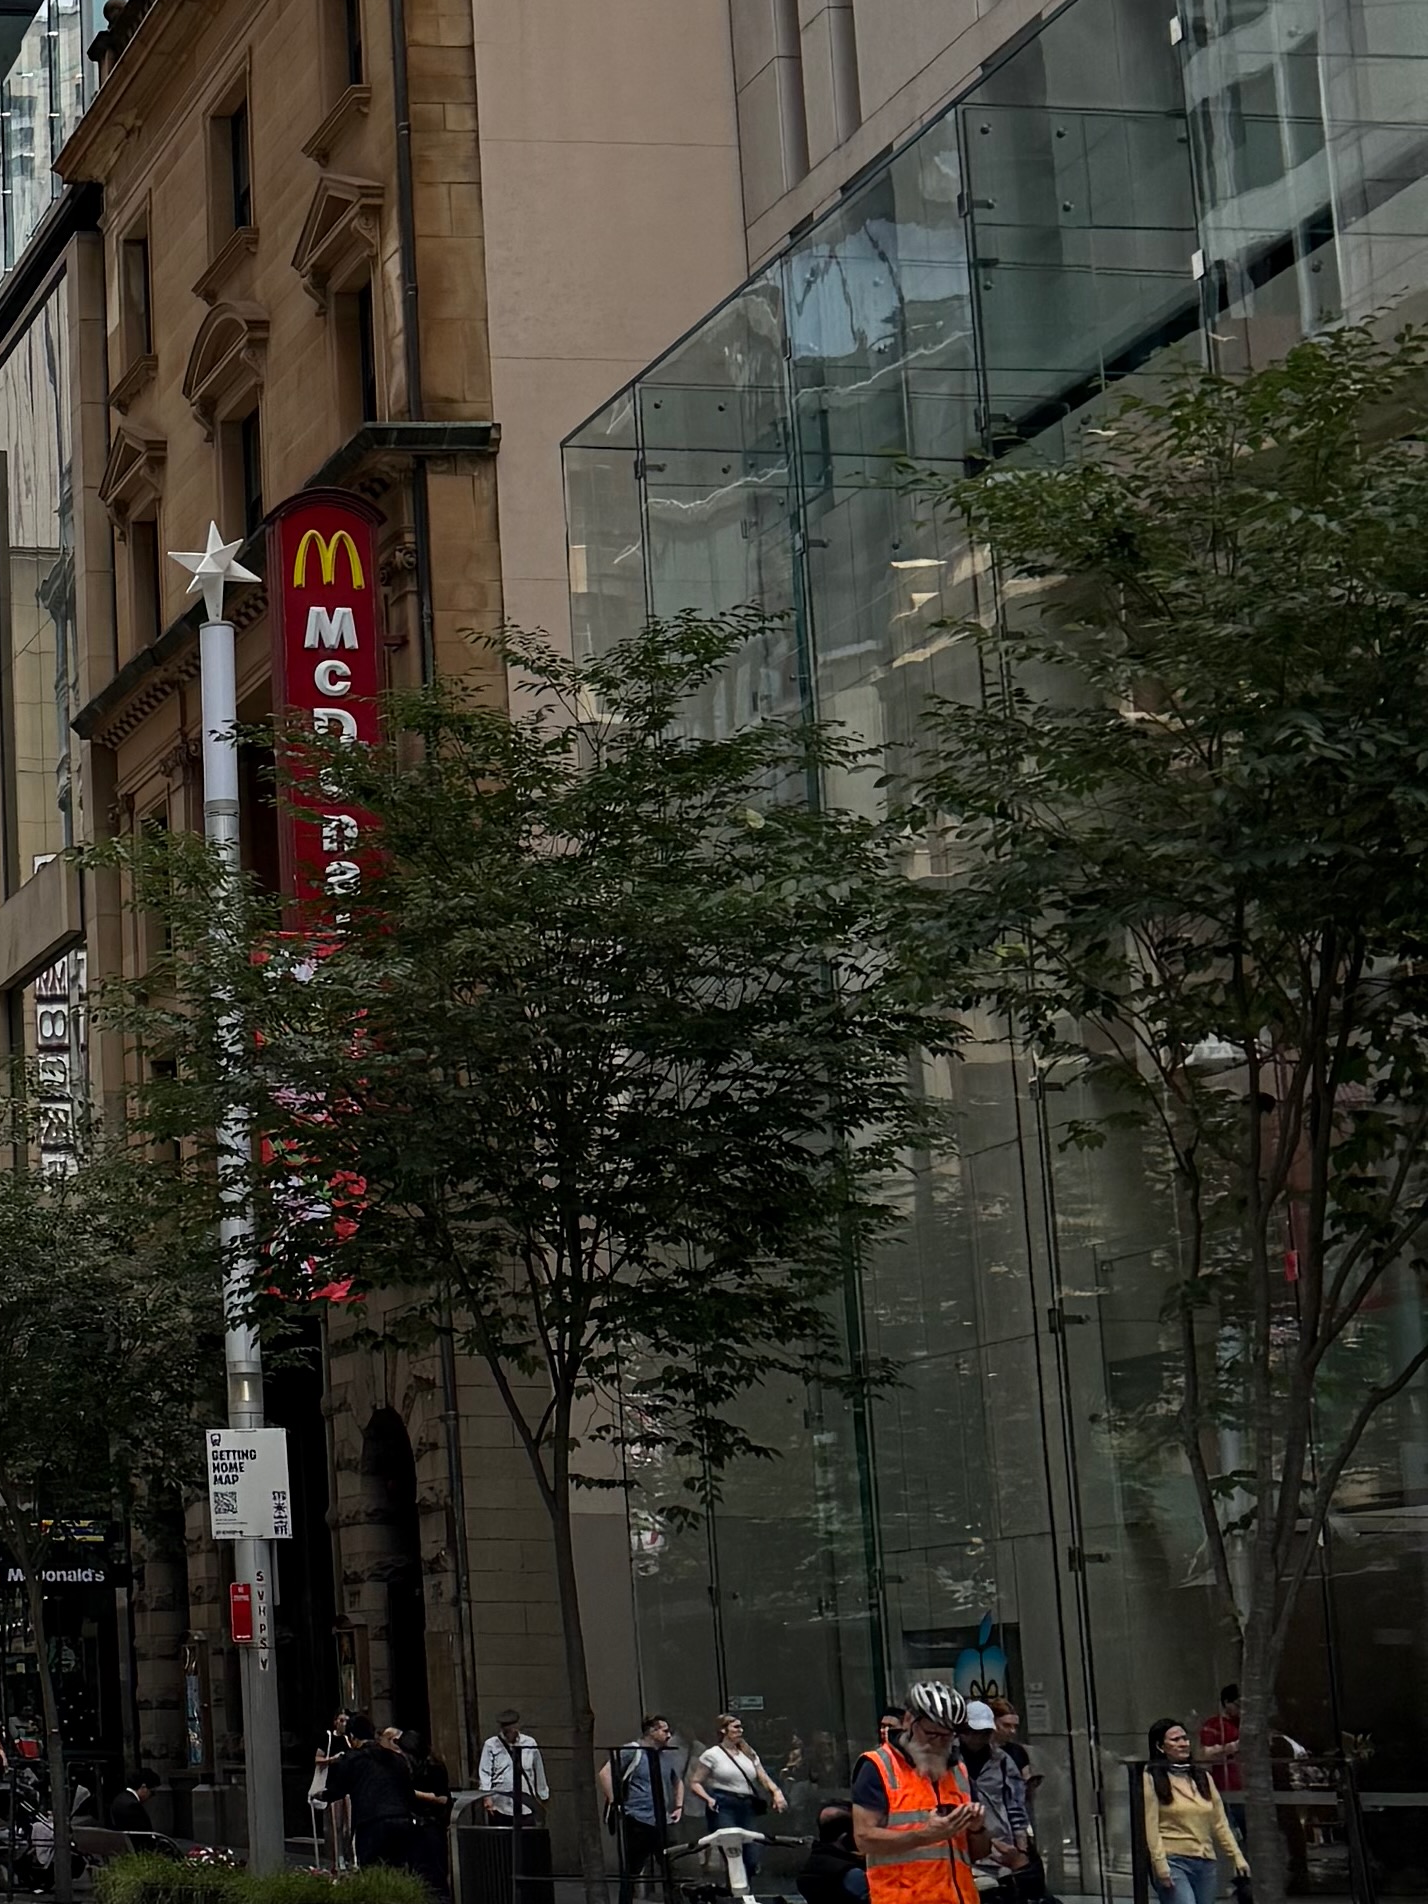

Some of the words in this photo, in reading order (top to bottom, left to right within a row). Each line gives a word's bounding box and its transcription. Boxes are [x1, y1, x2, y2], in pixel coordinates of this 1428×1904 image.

[211, 1449, 257, 1461] GETTING
[212, 1461, 245, 1473] HOME
[213, 1474, 239, 1486] MAP
[7, 1567, 105, 1583] Monald's
